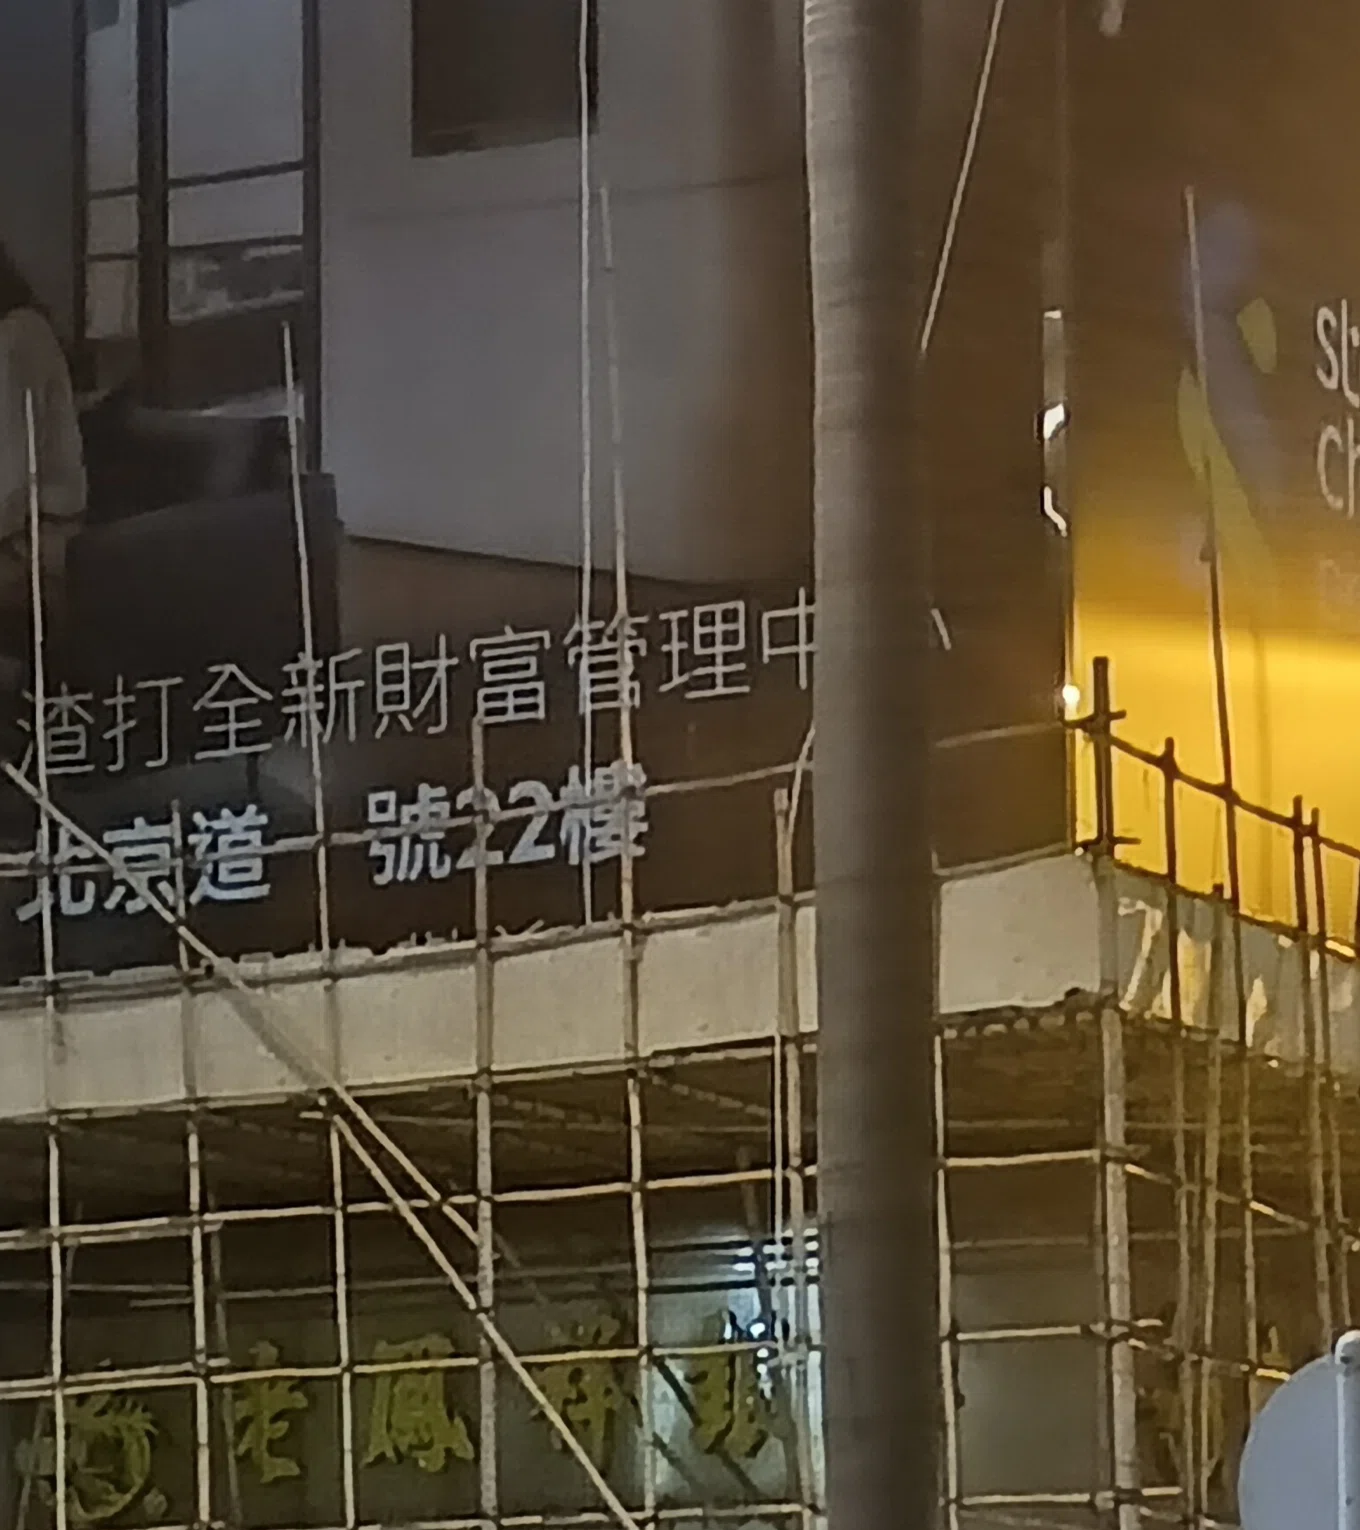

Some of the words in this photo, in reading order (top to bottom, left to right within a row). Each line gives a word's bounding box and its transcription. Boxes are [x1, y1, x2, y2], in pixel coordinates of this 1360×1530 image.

[21, 587, 950, 777] 渣打全新財富管理中
